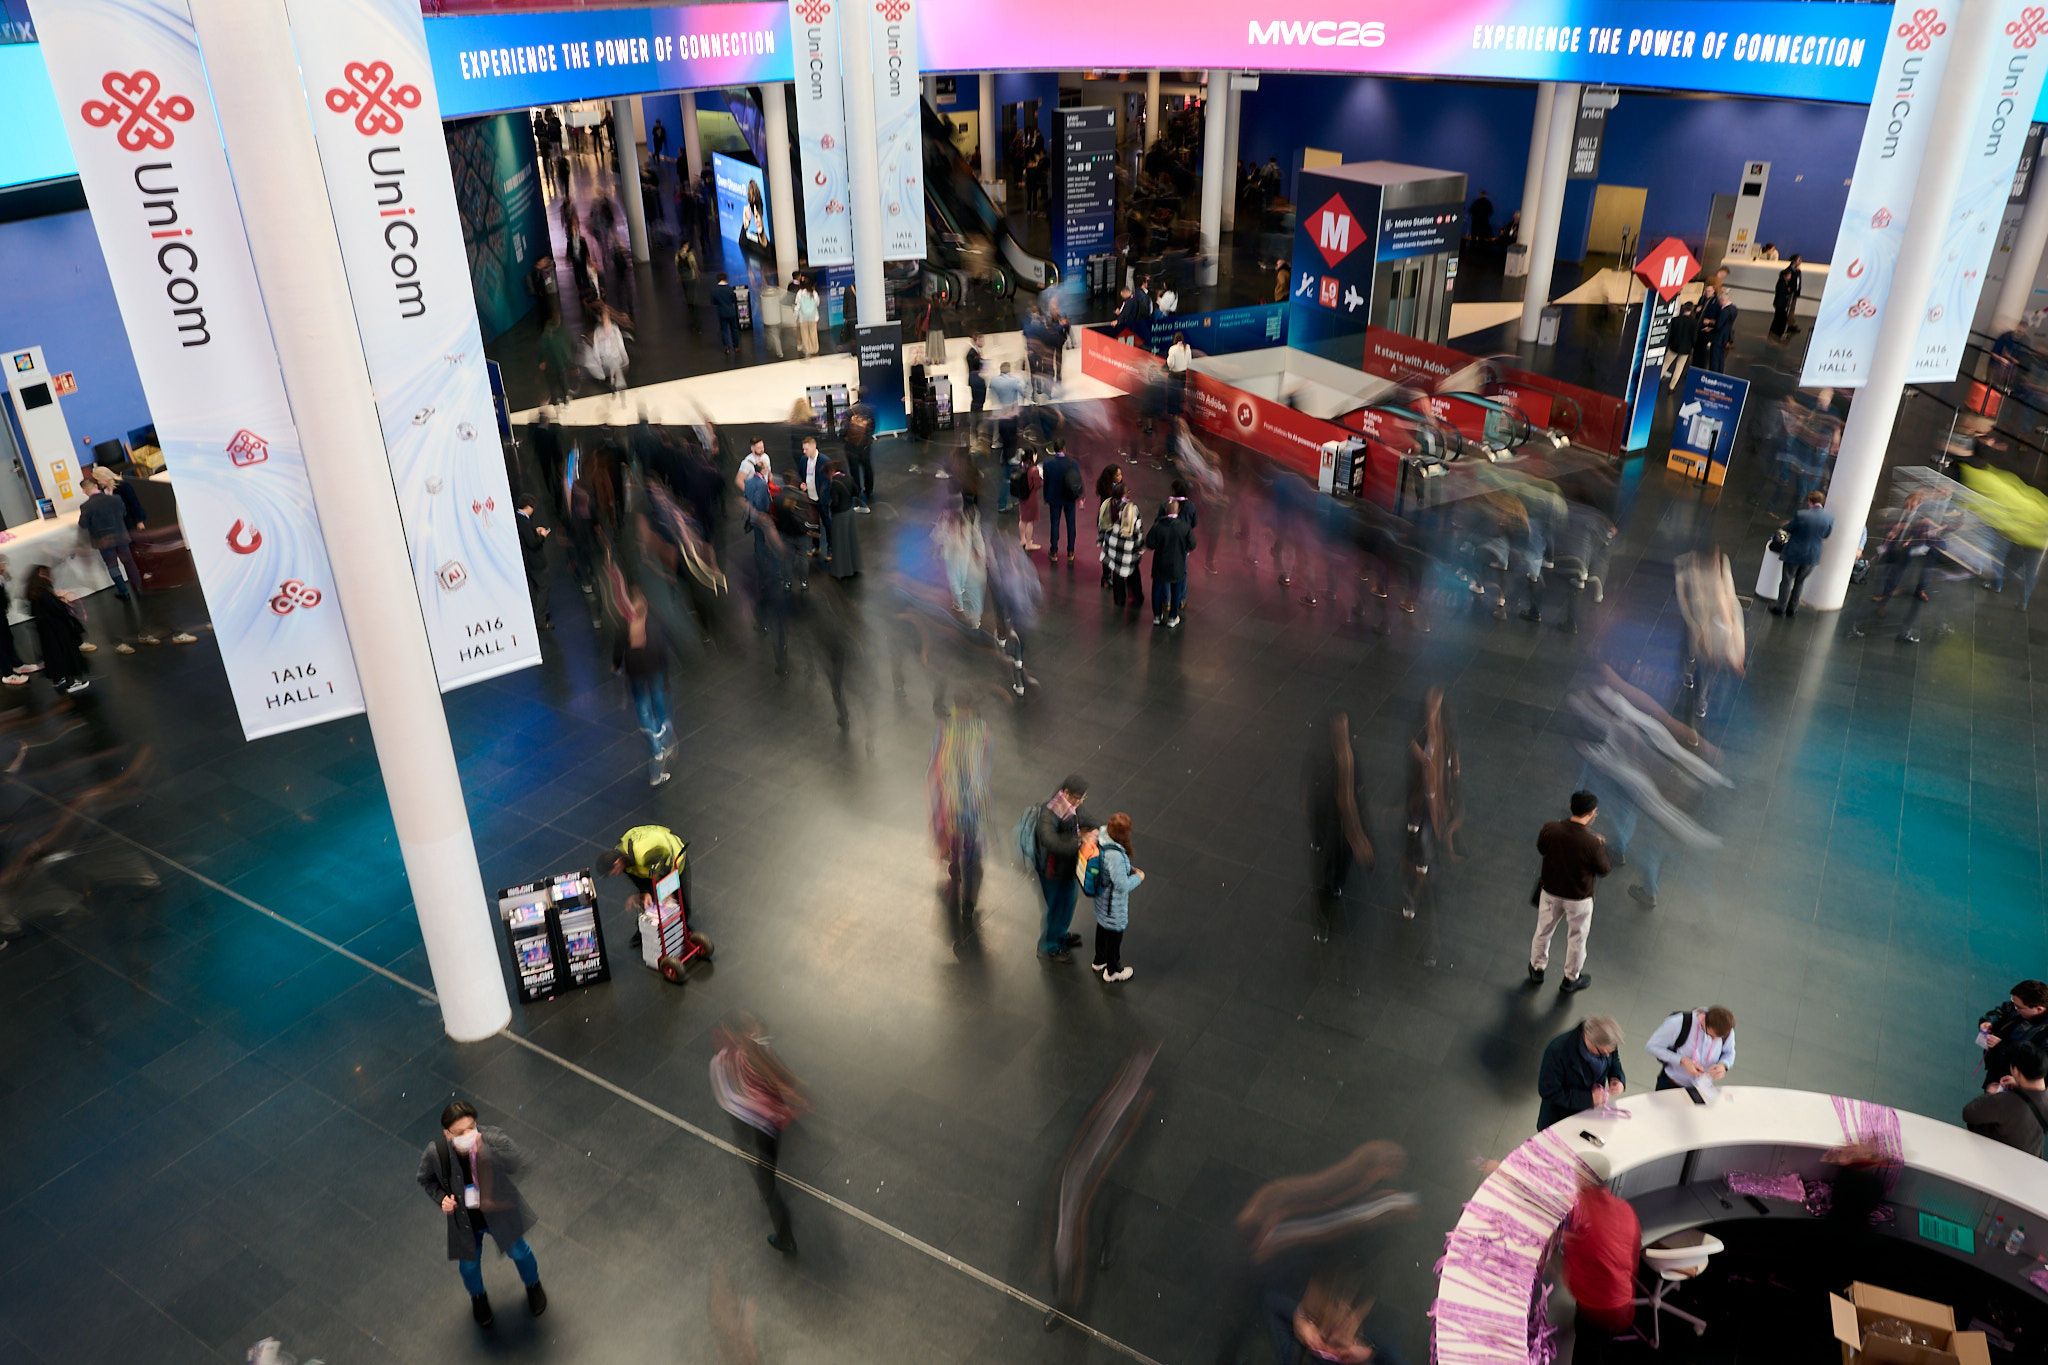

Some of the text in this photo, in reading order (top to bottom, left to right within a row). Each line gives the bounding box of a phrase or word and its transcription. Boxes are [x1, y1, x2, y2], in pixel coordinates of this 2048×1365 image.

[1248, 20, 1386, 47] MWC26
[460, 30, 775, 79] EXPERIENCE THE POWER OF CONNECTION
[1473, 25, 1866, 67] EXPERIENCE THE POWER OF CONNECTION
[808, 28, 823, 100] UniCom
[887, 25, 902, 97] UniCom
[1881, 57, 1923, 159] UniCom
[1984, 55, 2028, 156] UniCom
[368, 146, 427, 319] UniCom
[1320, 210, 1351, 253] M
[1394, 219, 1412, 228] Metro
[1413, 216, 1434, 226] Station
[818, 247, 836, 255] HALL
[822, 236, 838, 245] 1A16
[135, 163, 211, 348] UniCom
[1660, 255, 1689, 287] M
[1151, 323, 1173, 332] Metro
[1174, 319, 1199, 330] Station
[861, 344, 895, 352] Networking
[861, 352, 880, 360] Badge
[1374, 344, 1381, 355] It
[1381, 347, 1403, 363] starts
[1405, 355, 1422, 369] with
[1829, 349, 1853, 358] 1A16
[1926, 344, 1947, 354] 1A16
[862, 358, 892, 368] Reprinting
[1818, 363, 1847, 372] HALL
[1915, 359, 1940, 369] HALL
[1205, 393, 1228, 413] Adobe.
[1369, 411, 1383, 423] starts
[465, 617, 503, 637] 1A16
[459, 635, 517, 662] HALL 1
[272, 662, 317, 684] 1A16
[266, 682, 334, 709] HALL 1
